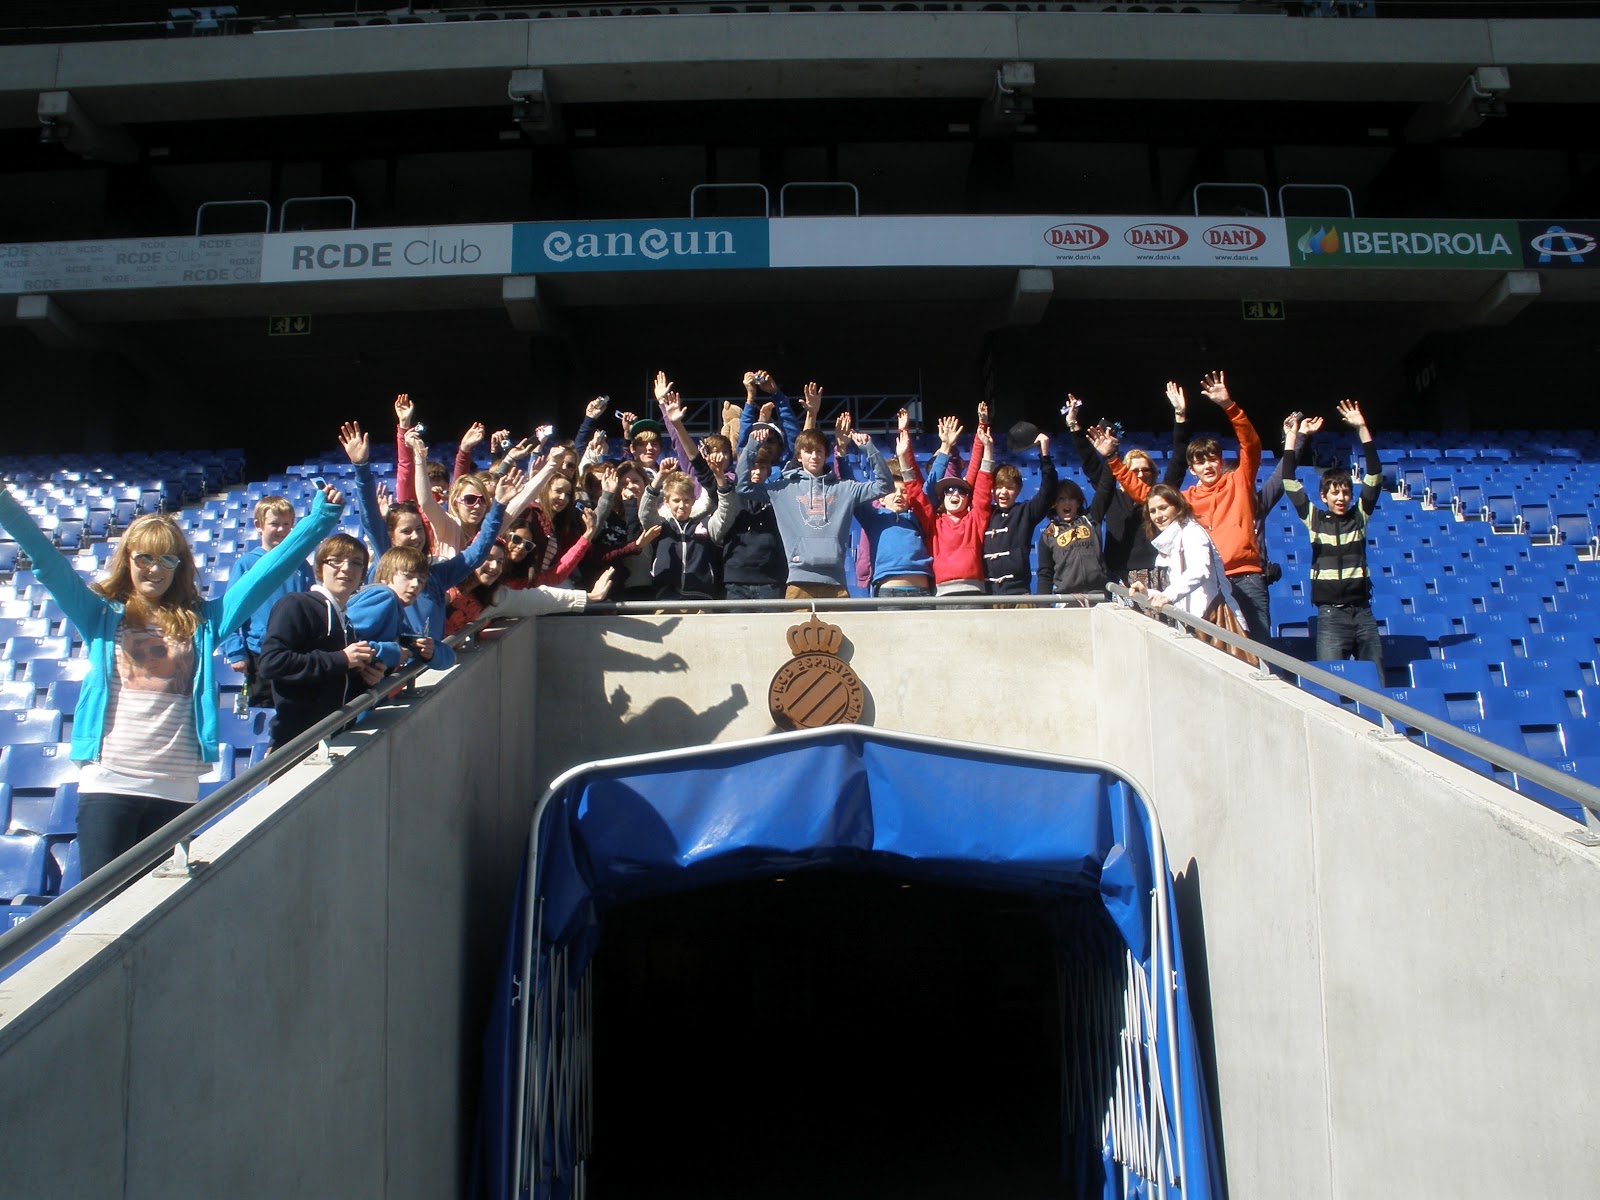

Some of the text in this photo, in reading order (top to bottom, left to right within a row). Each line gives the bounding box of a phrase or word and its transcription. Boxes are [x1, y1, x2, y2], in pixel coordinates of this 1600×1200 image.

[1051, 229, 1094, 245] DANI
[1131, 229, 1174, 245] DANI
[1208, 230, 1252, 246] DANI
[1342, 231, 1513, 255] IBERDROLA
[198, 239, 232, 249] RCDE
[543, 228, 737, 262] Cancun
[116, 251, 161, 265] RCDE
[292, 239, 482, 270] RCDE Club
[1055, 254, 1101, 262] www.dani.es
[1136, 254, 1181, 262] www.dani.es
[1214, 254, 1259, 262] www.dani.es
[182, 268, 230, 281] RCDE
[1468, 725, 1476, 733] 15
[45, 748, 55, 756] 14
[1561, 763, 1572, 771] 15
